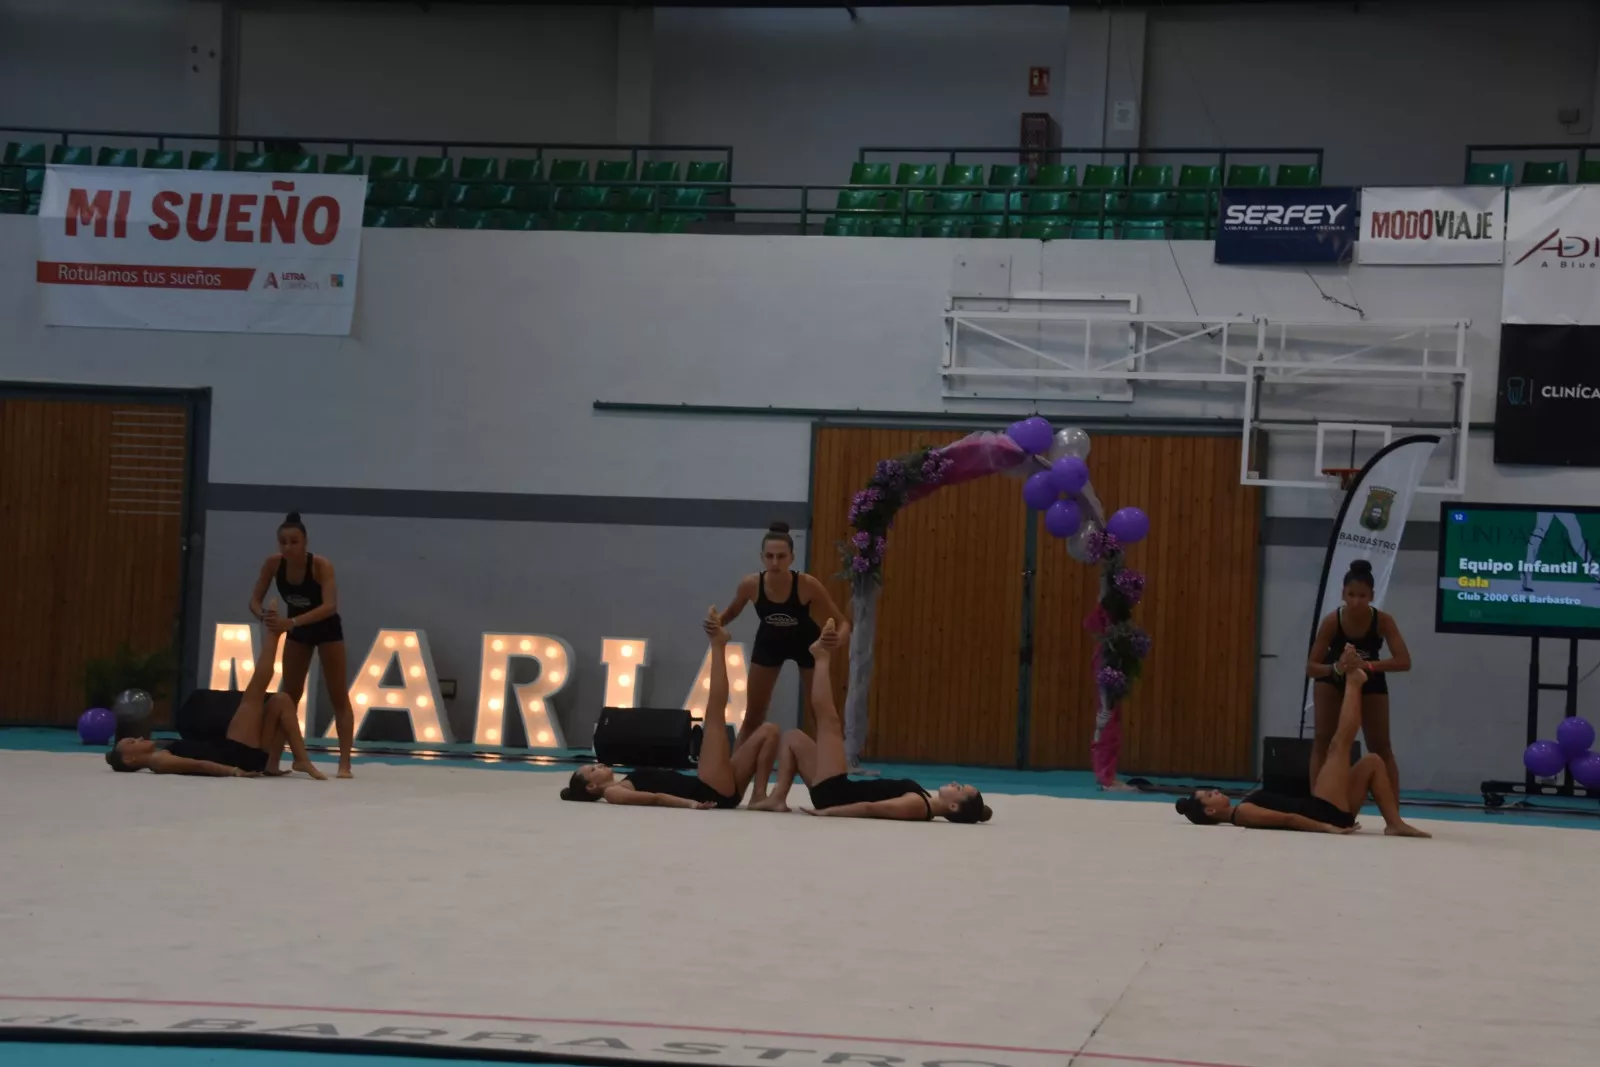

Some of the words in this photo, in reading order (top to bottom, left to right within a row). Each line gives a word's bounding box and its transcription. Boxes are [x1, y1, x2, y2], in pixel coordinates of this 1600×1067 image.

[65, 188, 131, 238] MI
[148, 181, 340, 245] SUEÑO
[1225, 204, 1348, 225] SERFEY
[1371, 209, 1493, 240] MODOVIAJE
[58, 265, 138, 283] Rotulamos
[143, 270, 166, 284] tus
[170, 271, 221, 286] sueños
[1339, 532, 1397, 550] BARBASTRO
[1459, 558, 1513, 574] Equipo
[1518, 560, 1577, 573] Infantil
[1458, 577, 1489, 588] Gala
[1457, 592, 1480, 600] Club
[1484, 593, 1508, 601] 2000
[1529, 595, 1581, 604] Barbastro
